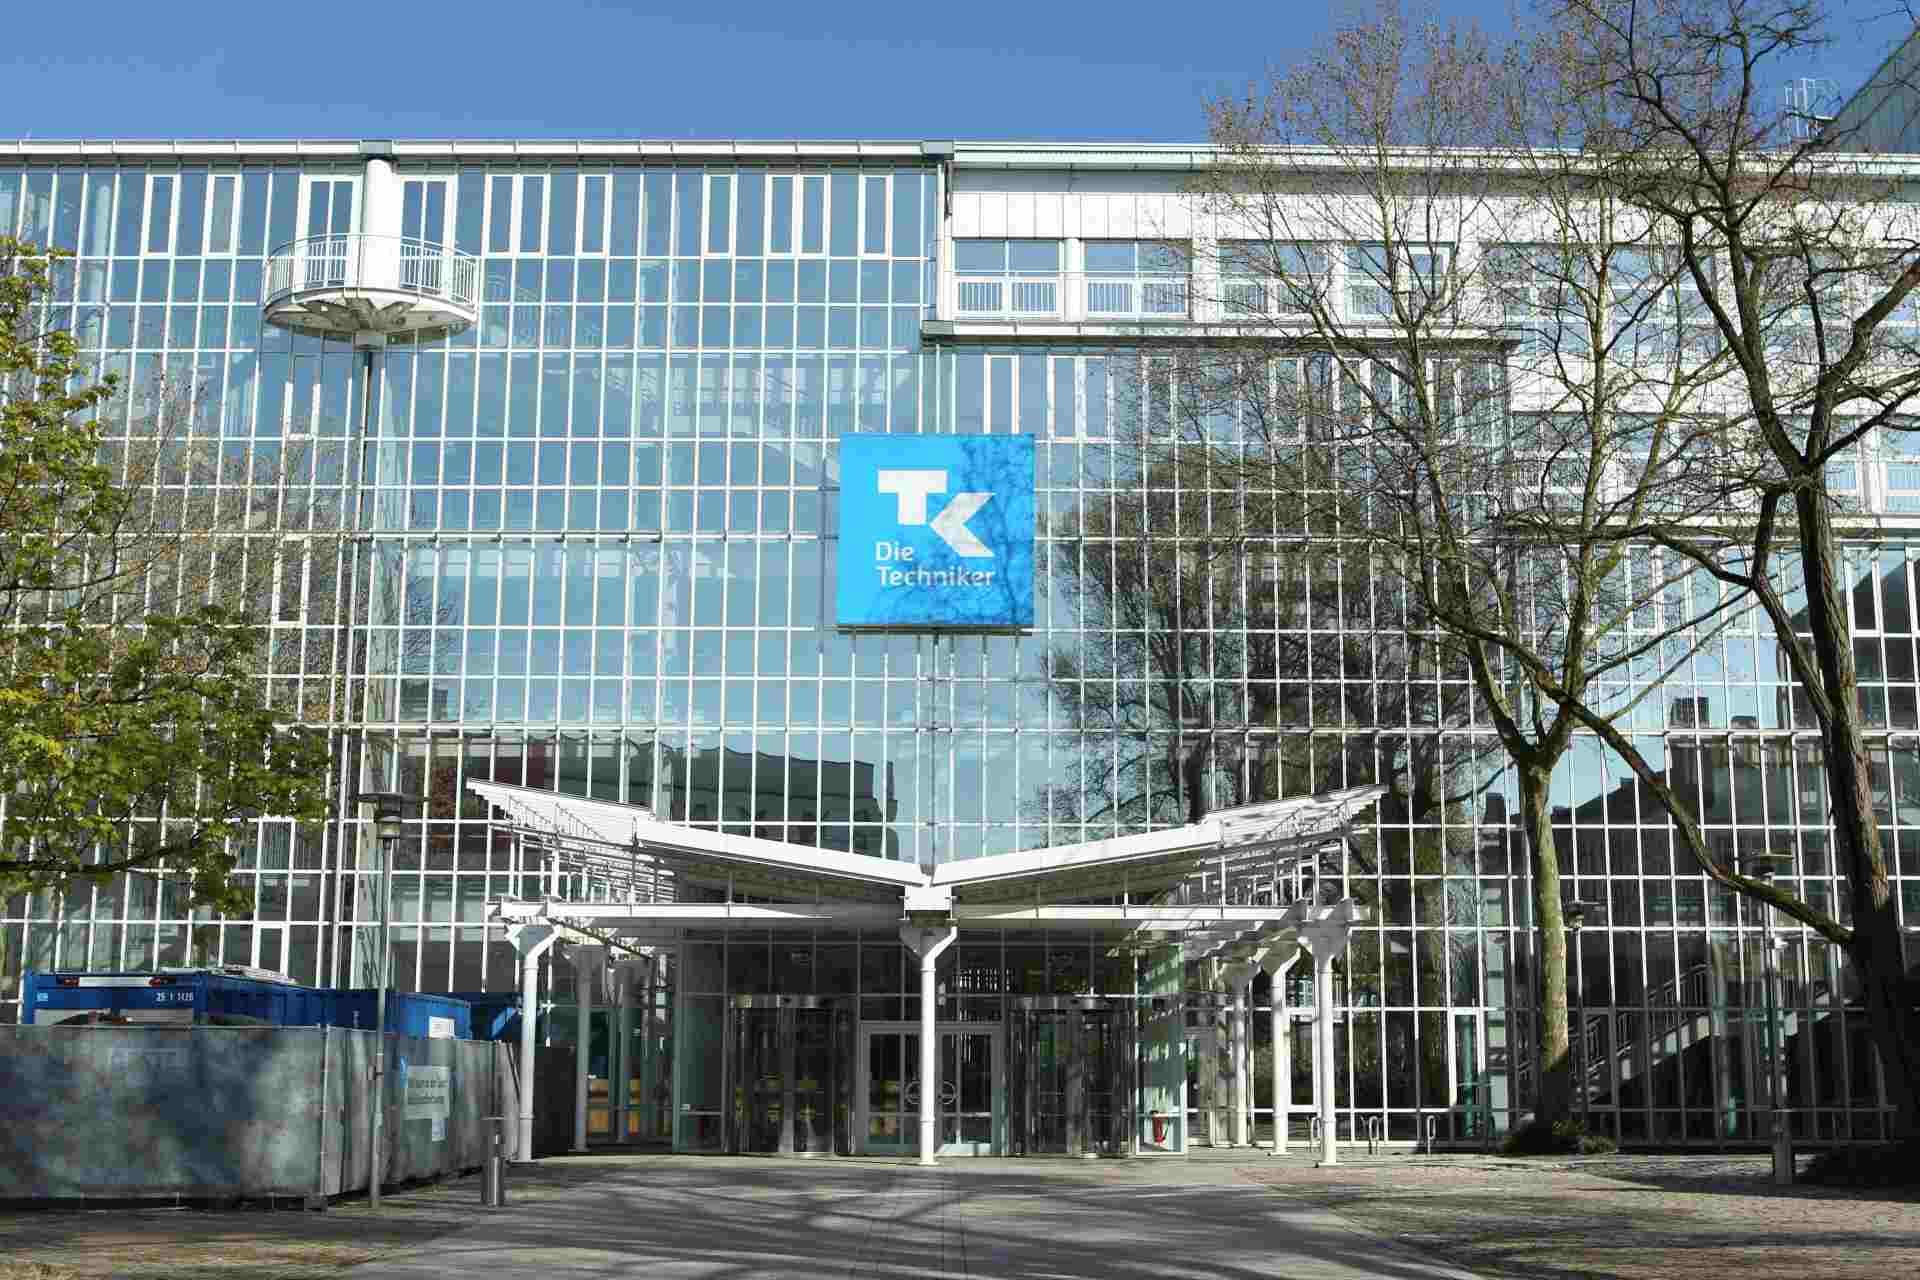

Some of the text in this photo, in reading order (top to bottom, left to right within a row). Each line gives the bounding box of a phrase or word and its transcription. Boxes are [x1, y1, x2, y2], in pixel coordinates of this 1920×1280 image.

[877, 469, 995, 558] TK
[875, 541, 914, 562] Die
[876, 565, 995, 587] Techniker
